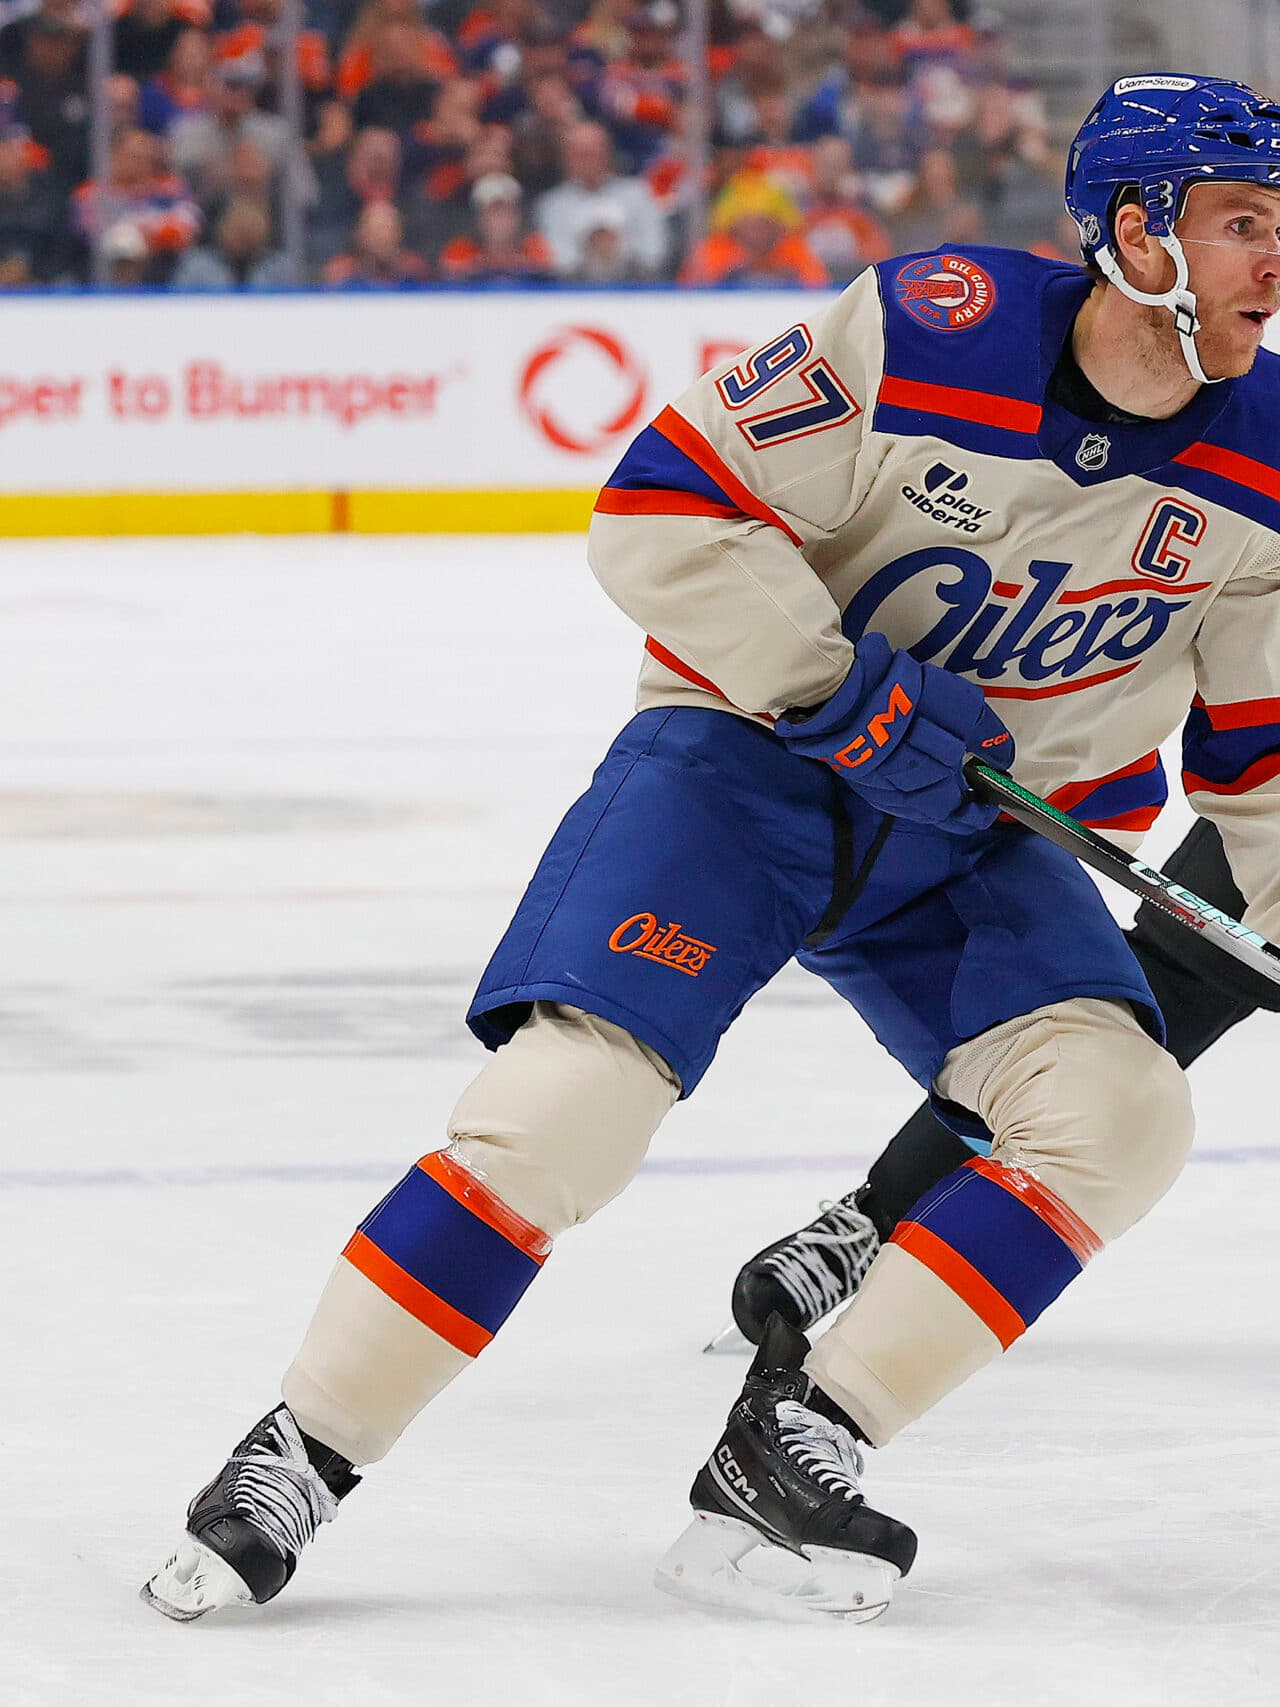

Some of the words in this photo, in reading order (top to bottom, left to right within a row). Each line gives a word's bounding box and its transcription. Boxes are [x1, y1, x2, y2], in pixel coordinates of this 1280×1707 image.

[948, 260, 971, 276] OIL
[954, 273, 988, 323] COUNTRY
[109, 367, 169, 419] to
[186, 362, 440, 427] Bumper
[714, 323, 863, 451] 97
[901, 485, 983, 533] alberta
[934, 492, 993, 520] play
[1131, 496, 1208, 584] C
[841, 546, 1190, 681] Oilers
[608, 911, 712, 972] Oilers
[716, 1443, 759, 1503] CCM
